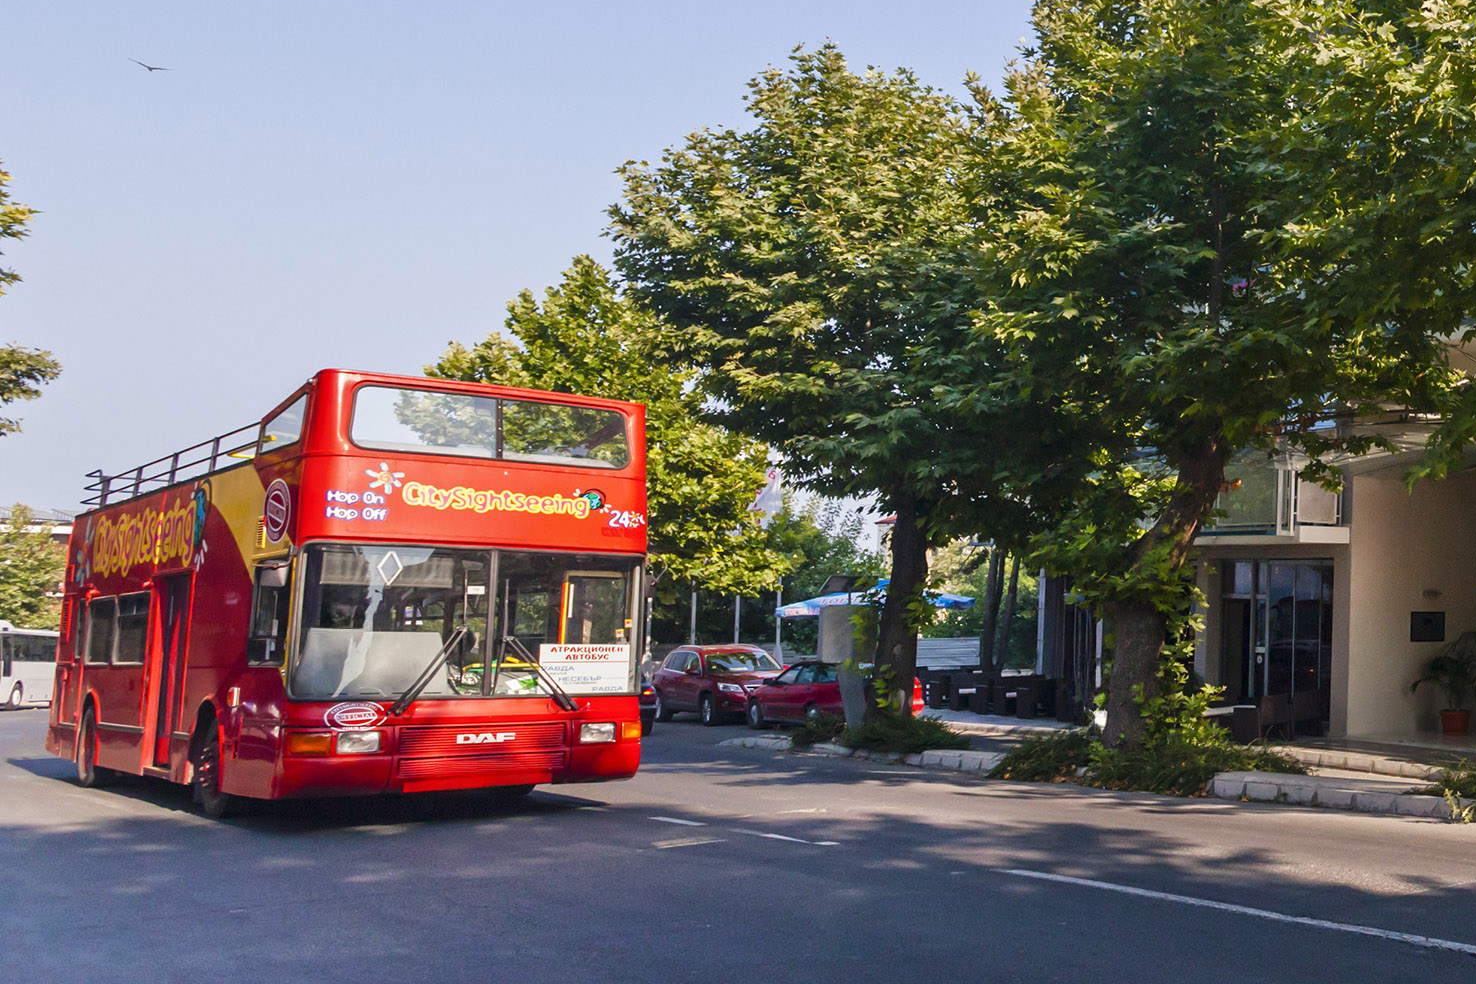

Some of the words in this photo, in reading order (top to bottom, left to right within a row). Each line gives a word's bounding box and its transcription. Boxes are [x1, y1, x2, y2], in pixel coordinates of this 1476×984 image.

[326, 490, 359, 504] Hop
[362, 491, 384, 505] On
[402, 481, 590, 519] CitySightseeing
[326, 506, 358, 520] Hop
[362, 507, 388, 521] Off
[550, 646, 623, 654] АТРАКЦИОНЕН
[456, 732, 516, 744] DAF
